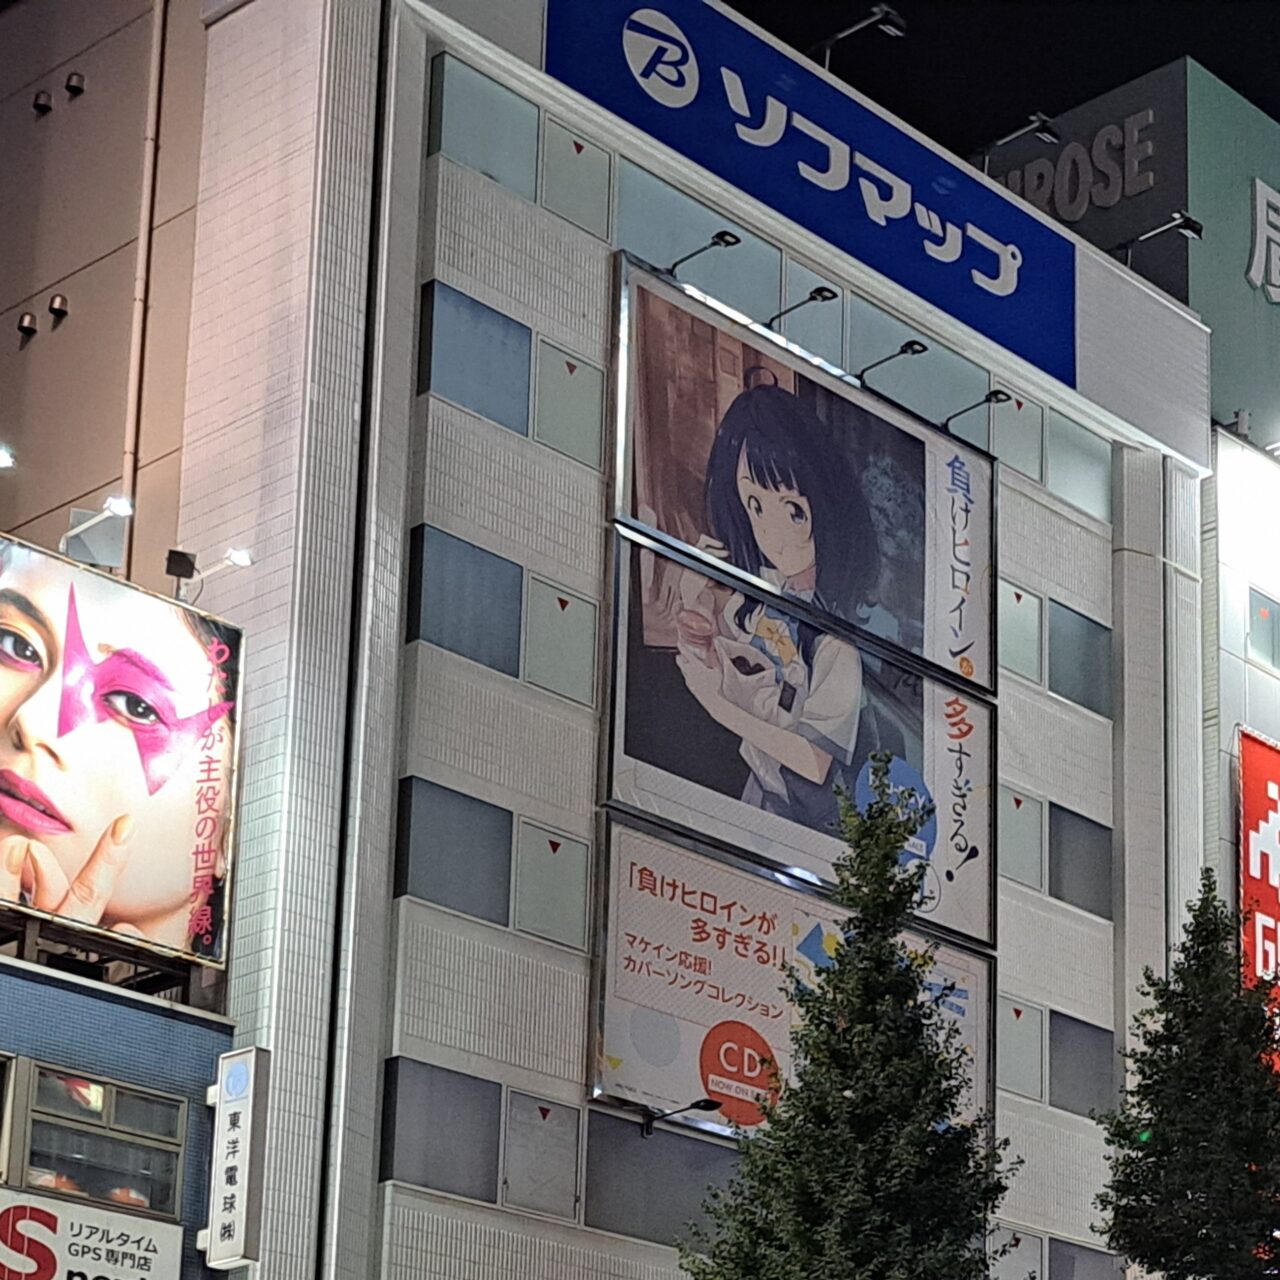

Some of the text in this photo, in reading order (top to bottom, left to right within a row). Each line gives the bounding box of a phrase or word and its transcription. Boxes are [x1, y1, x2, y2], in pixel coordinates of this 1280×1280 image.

[720, 66, 1023, 296] ソフマップ
[188, 636, 232, 945] わたしが主役の世界線。
[629, 861, 778, 935] 「負けヒロインが
[625, 931, 713, 976] マケイン応援!
[623, 955, 784, 1019] カバーソングコレクション
[718, 1042, 762, 1079] CD
[67, 1242, 153, 1272] GPS専門店
[68, 1221, 159, 1255] リアルタイム
